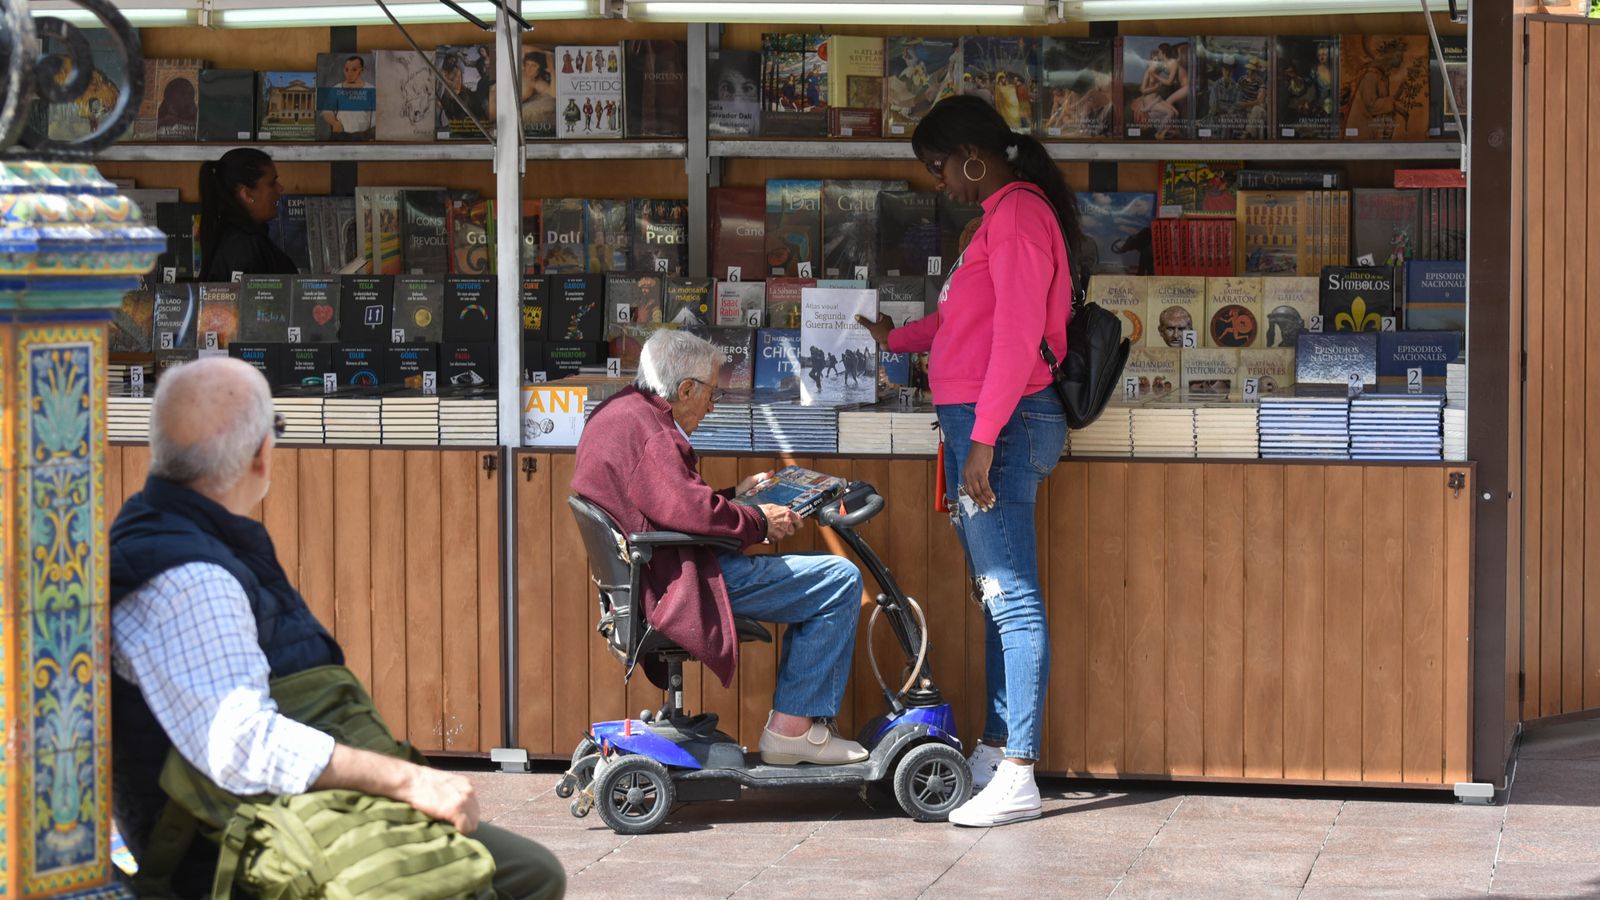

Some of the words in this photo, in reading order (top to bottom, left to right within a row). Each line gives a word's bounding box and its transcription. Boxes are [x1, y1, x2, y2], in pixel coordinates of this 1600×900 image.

[643, 72, 683, 81] FORTUNY
[547, 230, 581, 245] Dalí
[646, 231, 689, 245] Prad
[798, 263, 808, 278] 6
[927, 259, 939, 274] 10
[729, 270, 738, 281] 6
[1350, 271, 1371, 280] libro
[358, 282, 375, 290] TESLA
[166, 298, 182, 306] LADO
[202, 292, 237, 302] CEREBRO
[890, 292, 913, 301] DIGBY
[618, 306, 629, 321] 6
[748, 311, 758, 326] 6
[814, 312, 847, 322] Segunda
[805, 320, 833, 329] Guerra
[1309, 315, 1319, 331] 2
[1183, 332, 1193, 347] 5
[1397, 345, 1443, 353] EPISODIOS
[1393, 353, 1447, 361] NACIONALES
[607, 359, 619, 375] 4
[1185, 367, 1237, 376] TEUTOBURGO
[1349, 373, 1359, 388] 2
[1408, 369, 1420, 387] 2
[1244, 379, 1255, 395] 5
